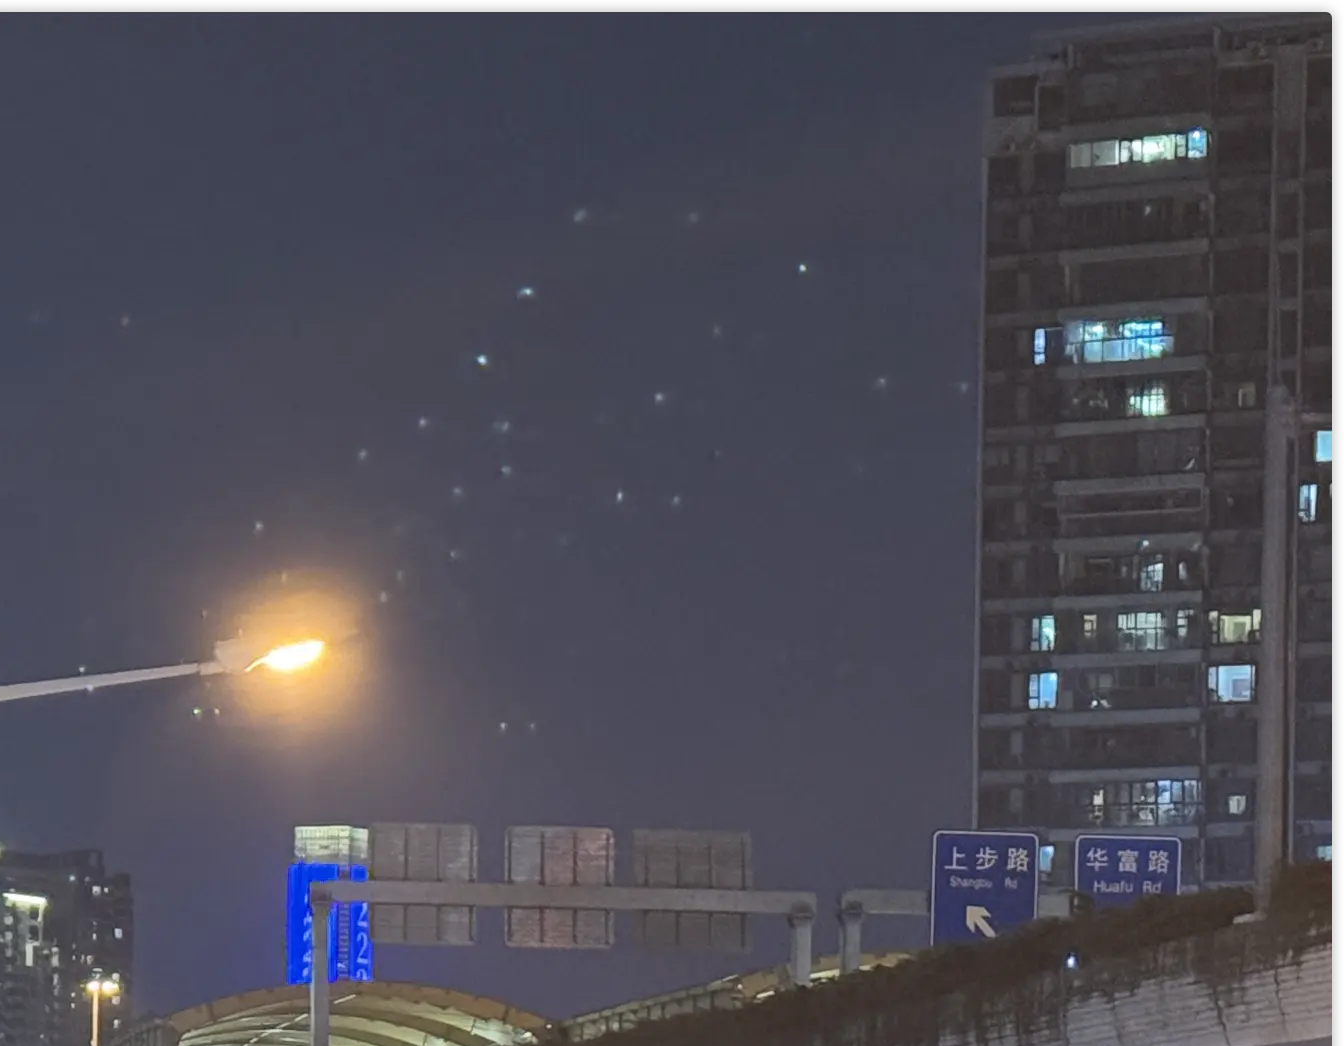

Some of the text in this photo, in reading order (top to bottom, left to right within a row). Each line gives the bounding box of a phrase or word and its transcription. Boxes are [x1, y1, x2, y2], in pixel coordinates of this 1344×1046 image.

[943, 846, 1029, 872] 上步路
[1086, 847, 1170, 874] 华富路
[1093, 880, 1162, 894] Huafu Rd
